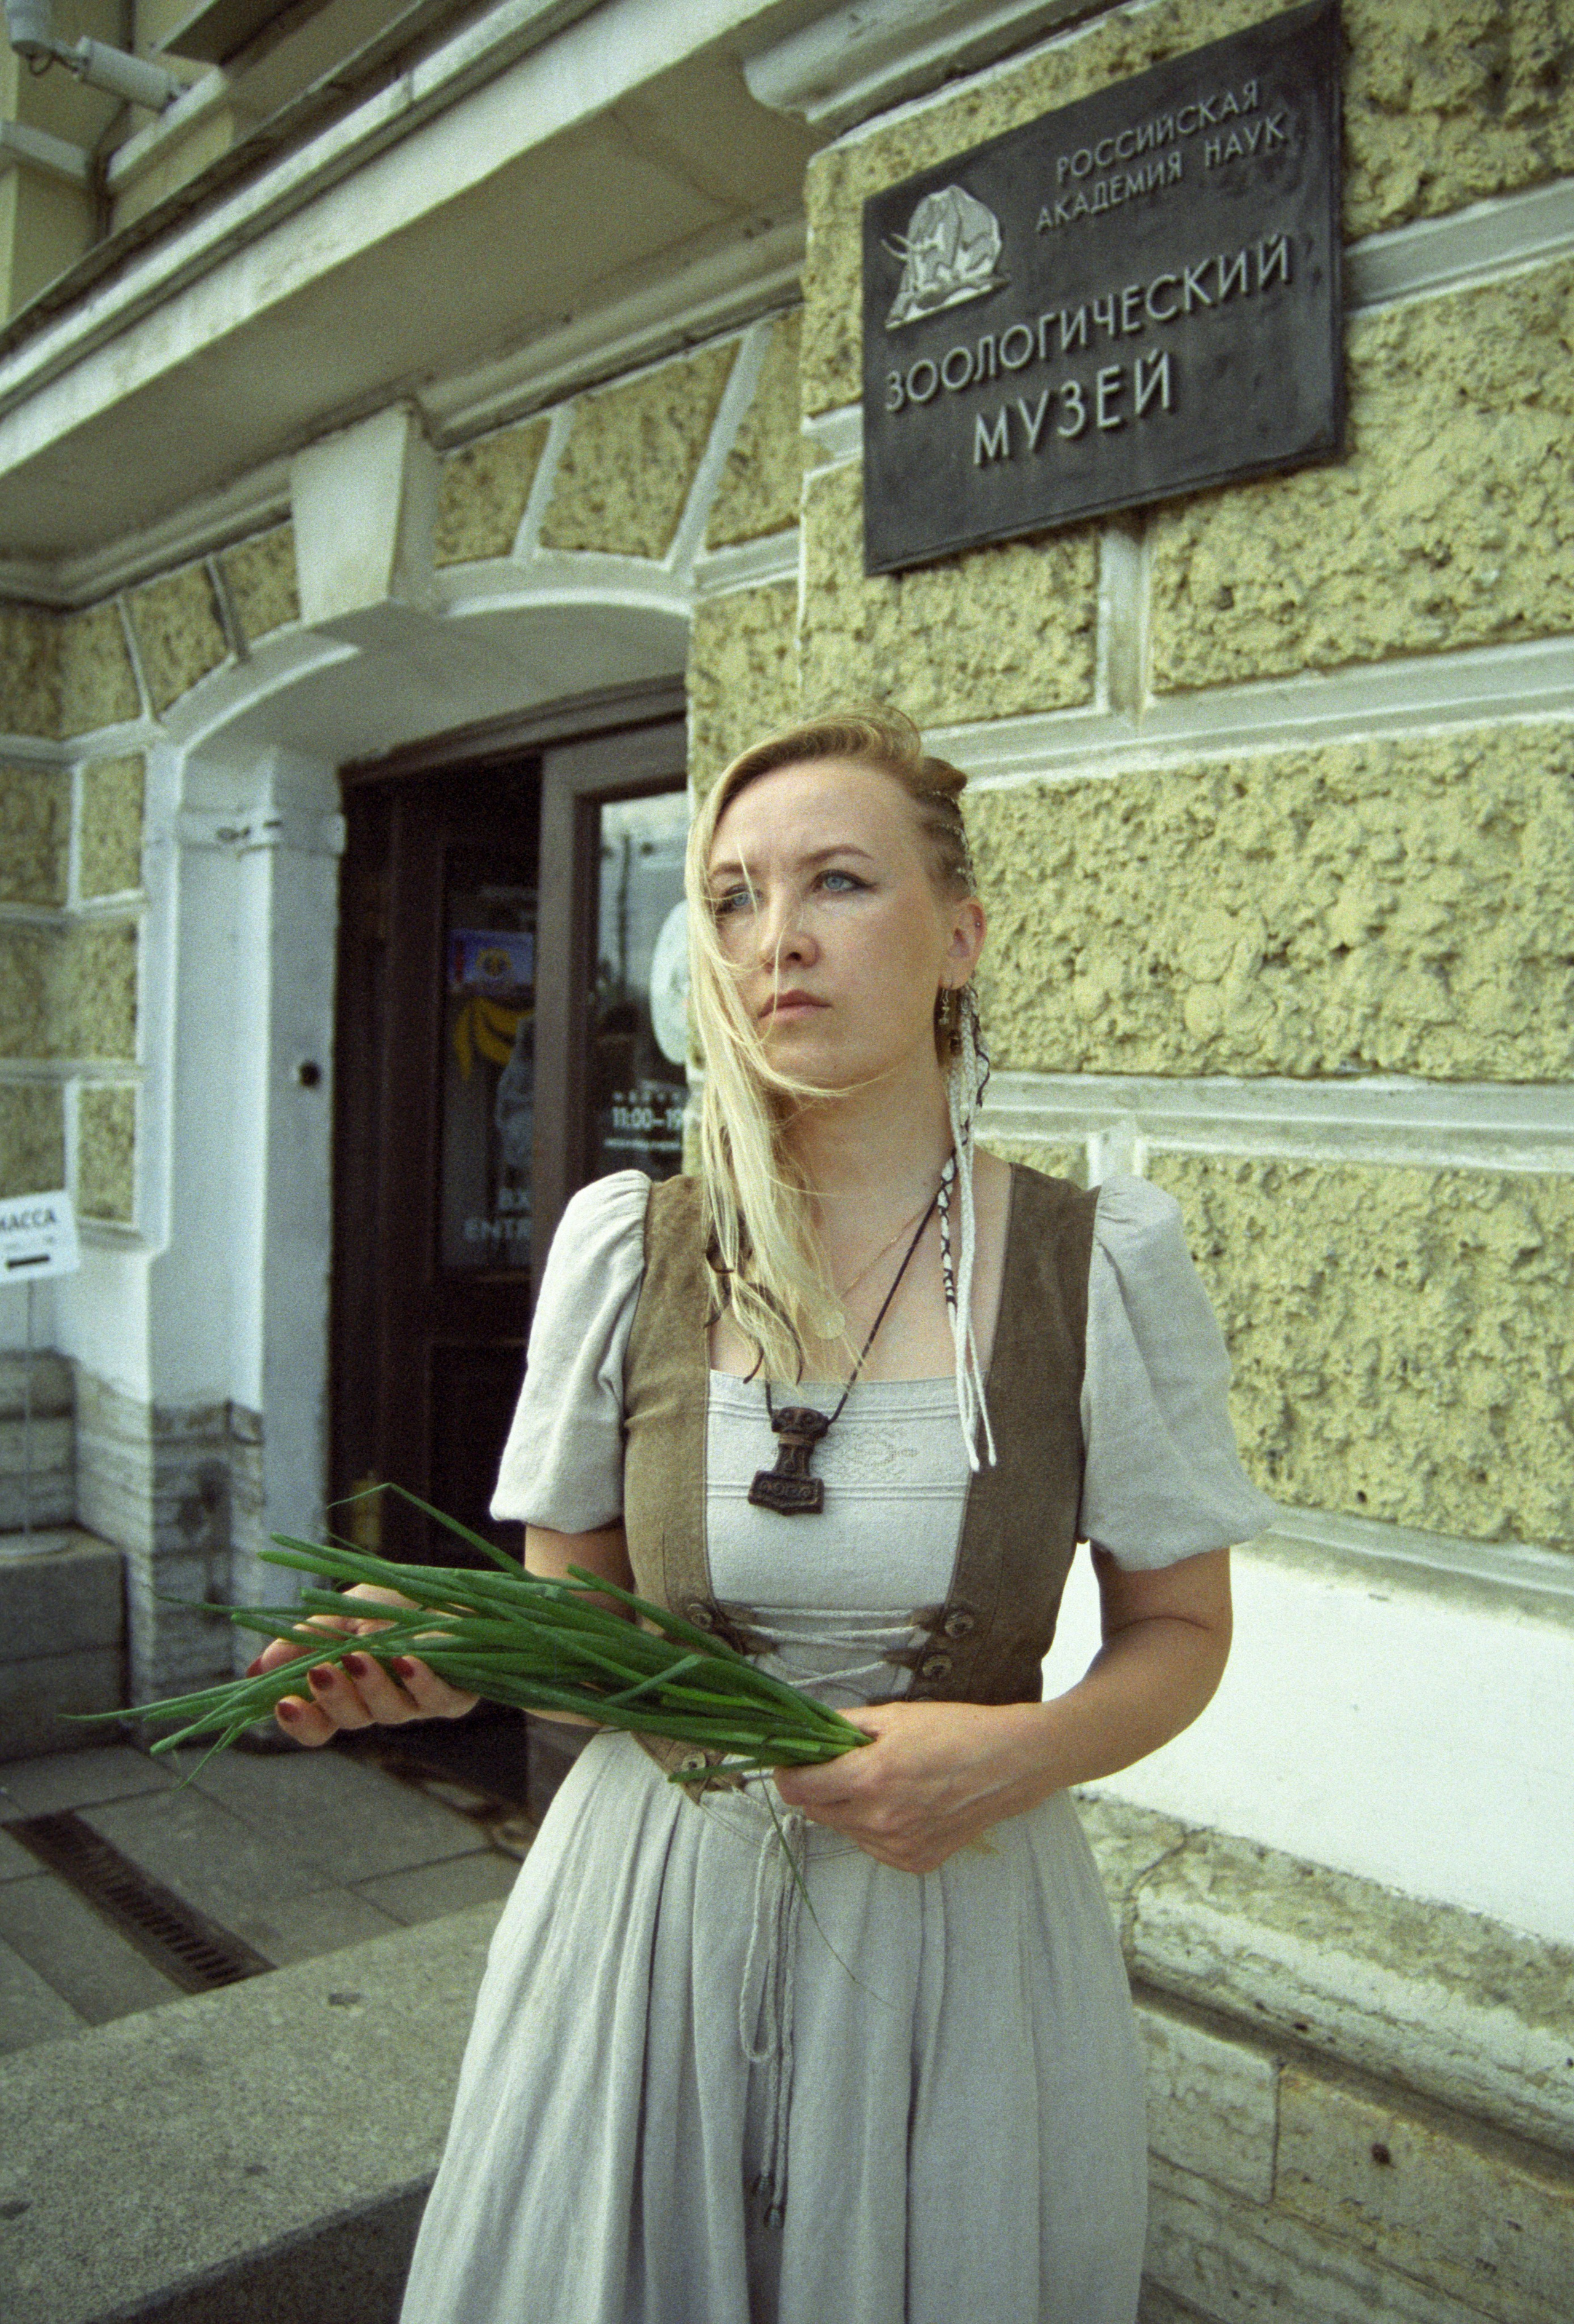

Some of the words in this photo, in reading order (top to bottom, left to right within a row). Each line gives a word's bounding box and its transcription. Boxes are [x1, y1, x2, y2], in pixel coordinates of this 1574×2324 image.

[1036, 151, 1182, 232] АКАДЕМИЯ
[1204, 111, 1288, 168] НАУК
[1056, 79, 1259, 183] РОССИЙСКАЯ
[884, 233, 1290, 411] ЗООЛОГИЧЕСКИЙ
[973, 347, 1171, 465] МУЗЕЙ
